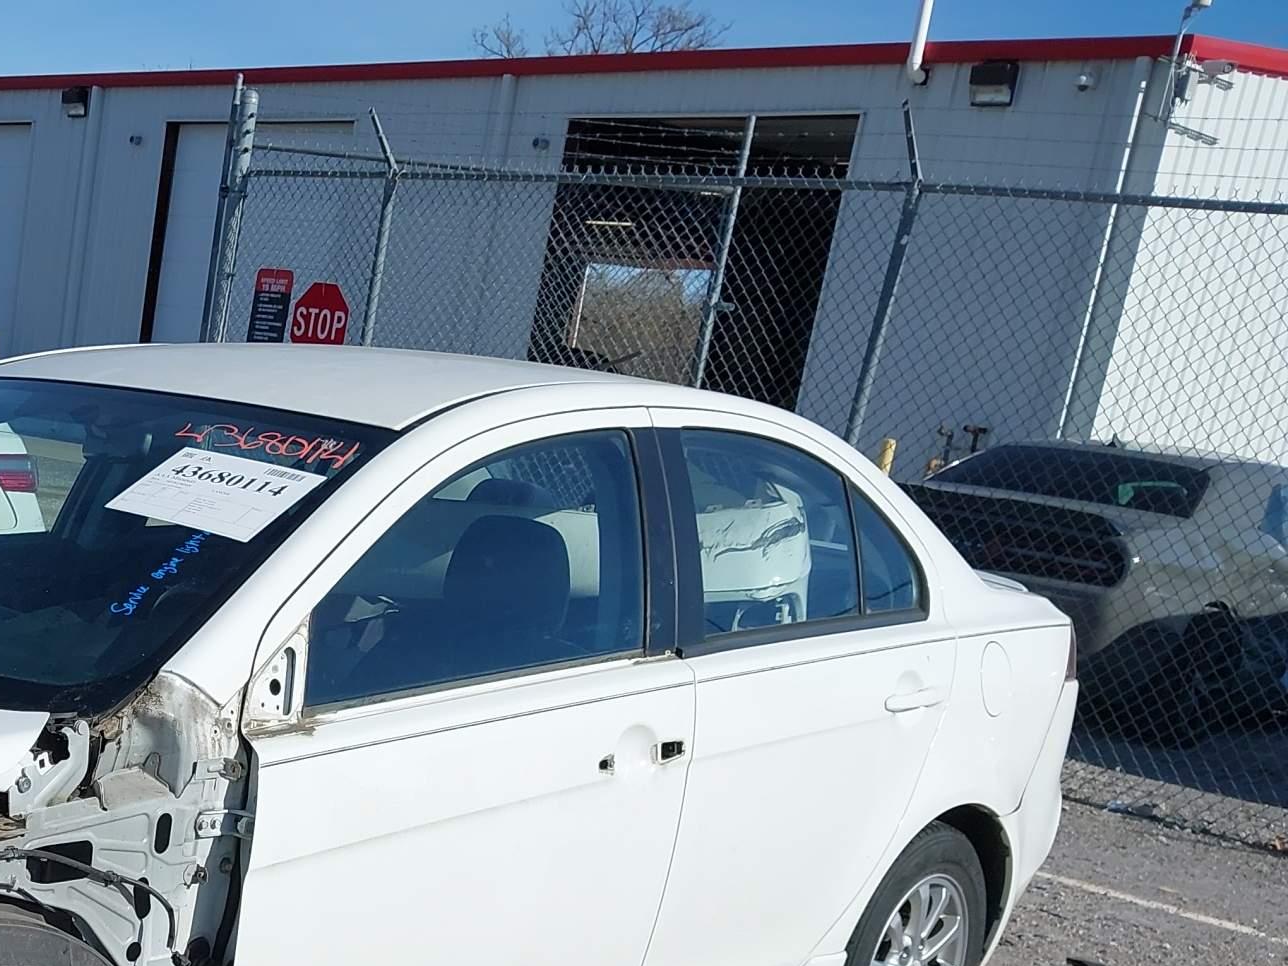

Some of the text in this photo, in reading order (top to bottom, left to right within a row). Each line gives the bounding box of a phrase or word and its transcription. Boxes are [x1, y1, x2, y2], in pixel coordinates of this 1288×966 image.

[293, 306, 346, 341] STOP
[175, 423, 360, 469] 43680114
[172, 464, 289, 497] 43680114
[110, 585, 150, 616] Service
[151, 557, 185, 580] engine
